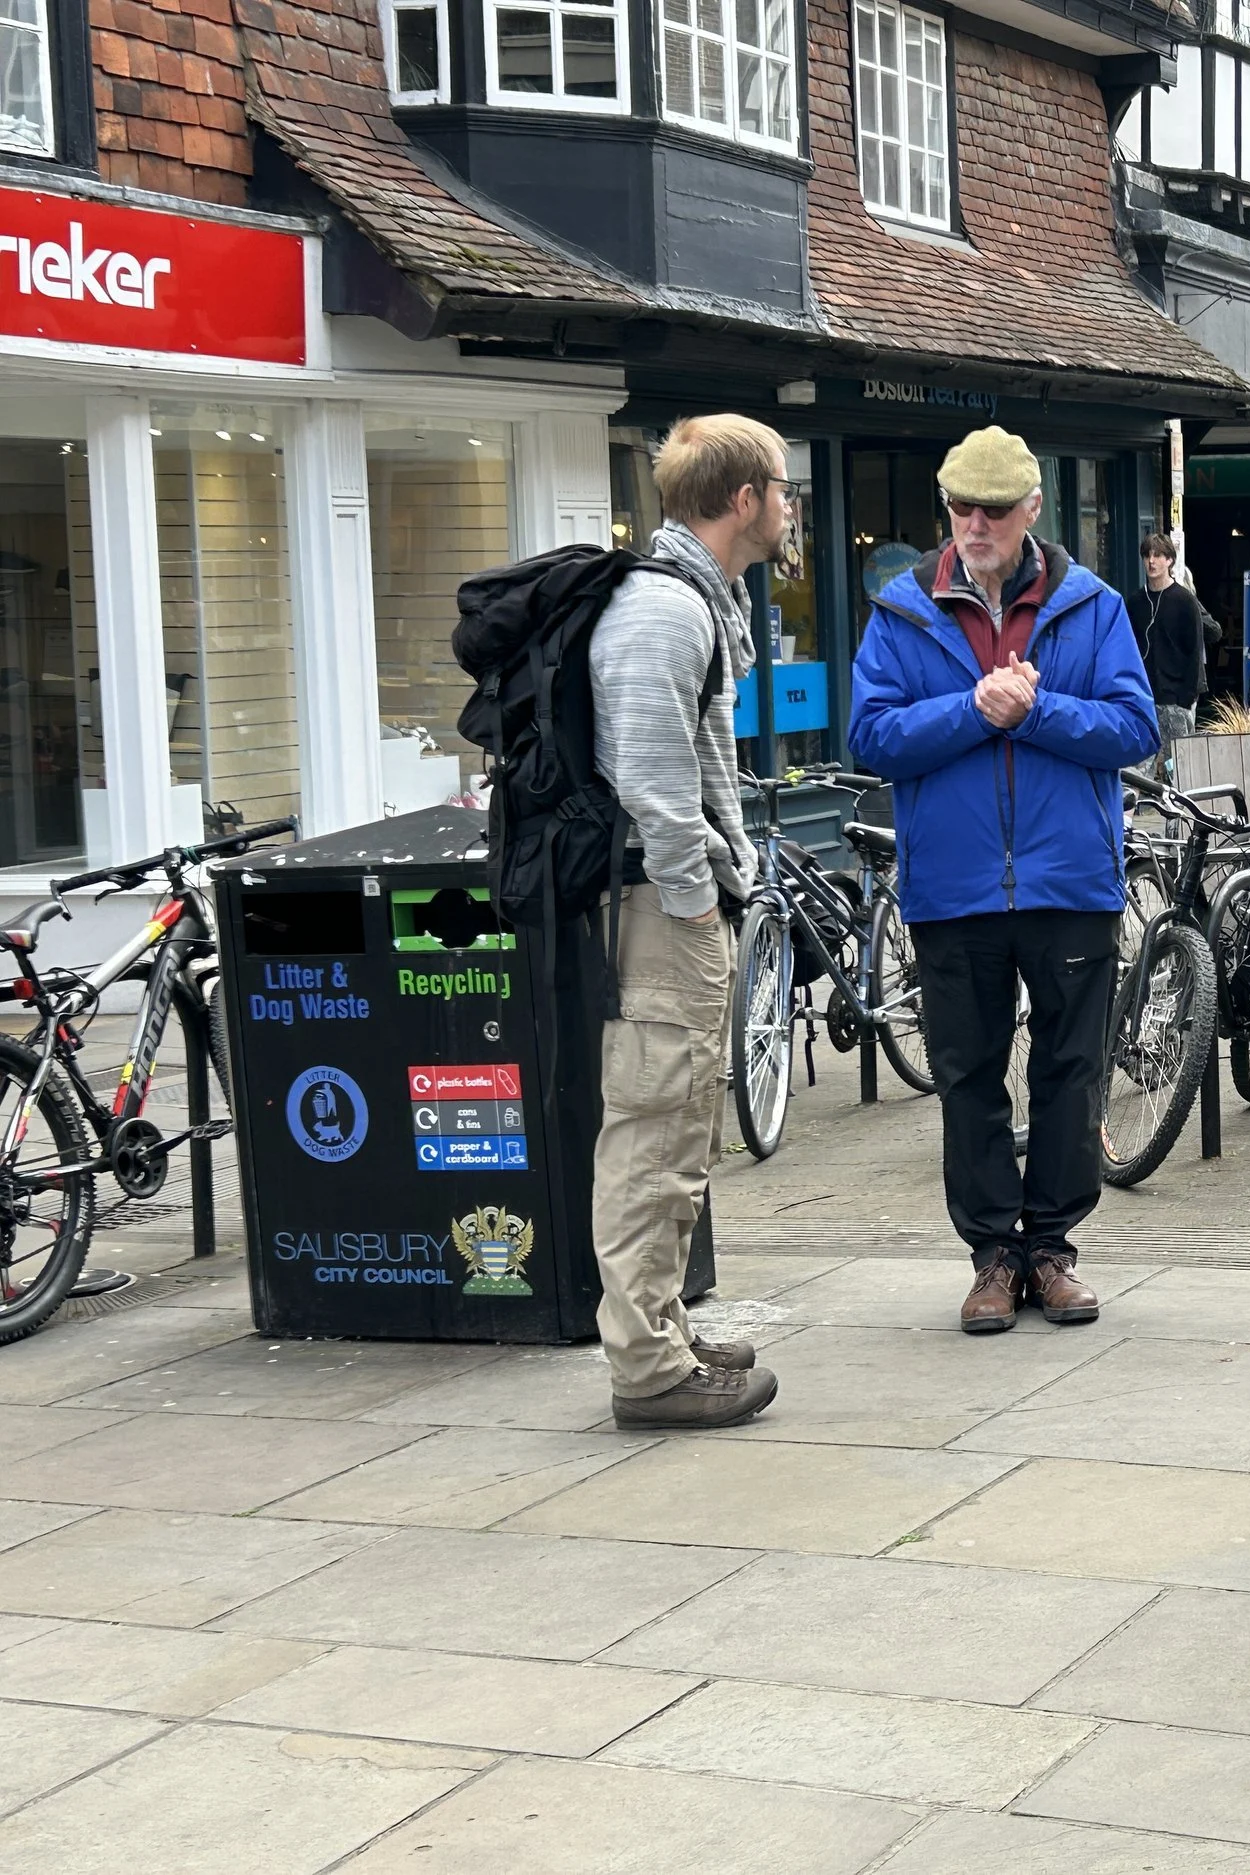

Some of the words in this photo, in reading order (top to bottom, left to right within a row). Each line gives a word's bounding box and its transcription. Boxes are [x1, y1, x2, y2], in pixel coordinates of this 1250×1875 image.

[786, 690, 808, 703] TEA
[264, 963, 324, 990] Litter
[331, 961, 348, 988] &
[250, 994, 294, 1025] Dog
[300, 993, 370, 1020] Waste
[304, 1070, 341, 1085] LITTER
[437, 1077, 463, 1090] plastic
[465, 1076, 492, 1087] bottles
[458, 1109, 477, 1117] cans
[457, 1120, 464, 1129] &
[303, 1137, 327, 1157] DOG
[328, 1137, 360, 1158] WASTE
[450, 1143, 480, 1153] paper
[483, 1141, 491, 1151] &
[445, 1153, 499, 1163] cardboard
[273, 1232, 450, 1263] SALISBURY
[314, 1267, 359, 1283] CITY
[363, 1268, 453, 1285] COUNCIL
